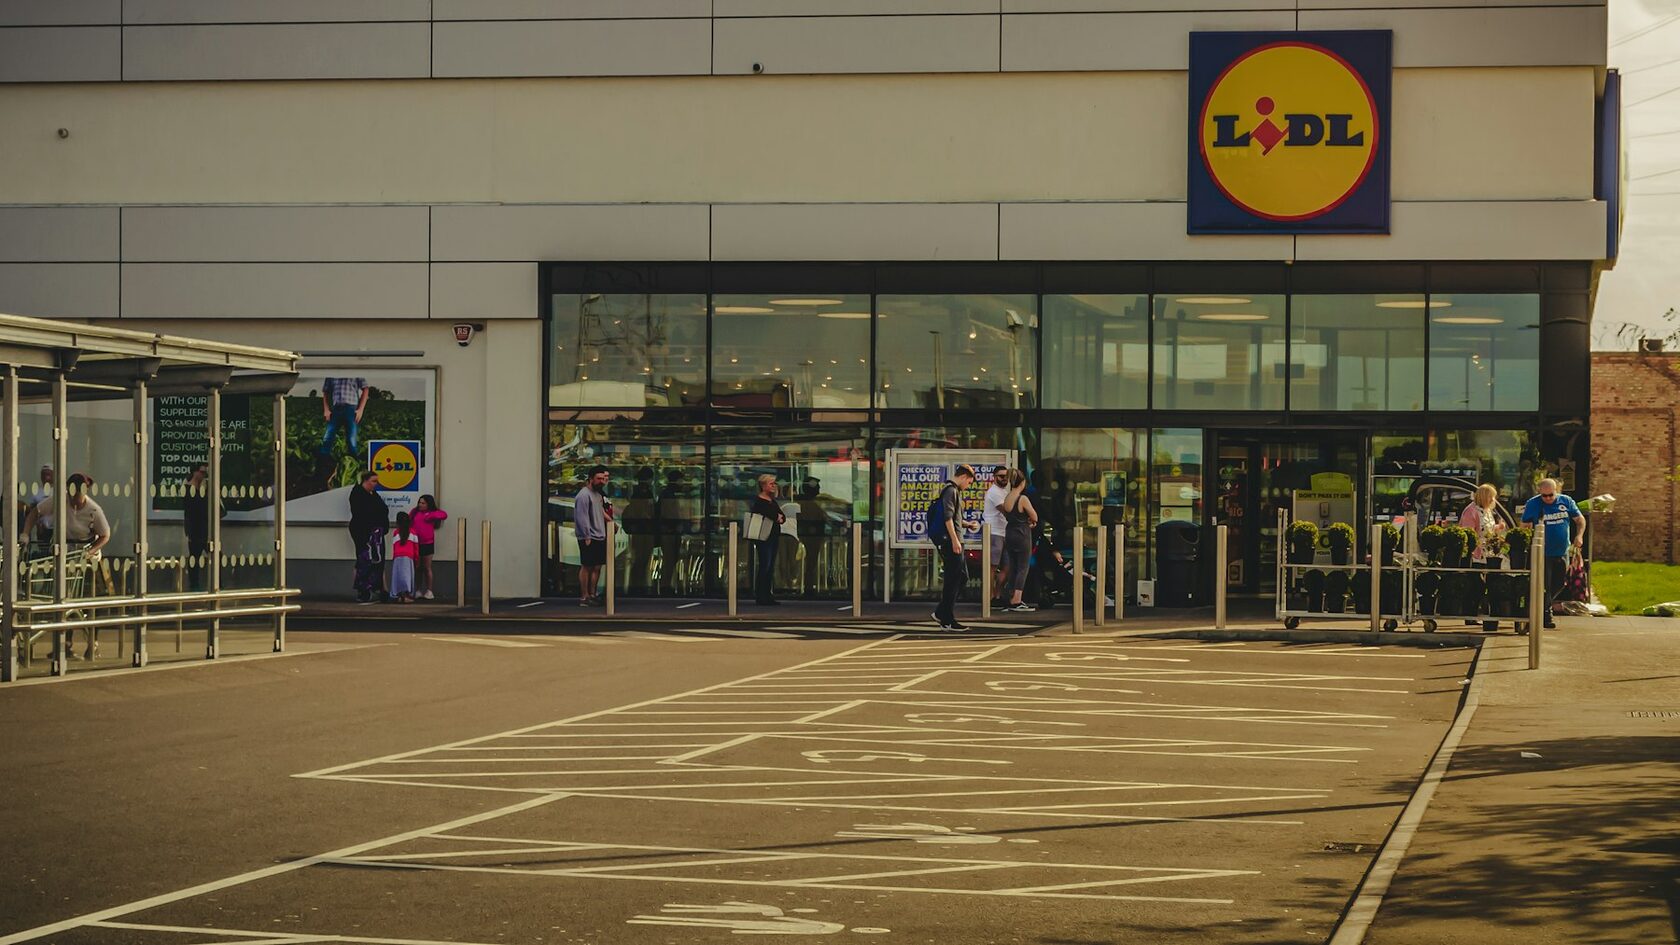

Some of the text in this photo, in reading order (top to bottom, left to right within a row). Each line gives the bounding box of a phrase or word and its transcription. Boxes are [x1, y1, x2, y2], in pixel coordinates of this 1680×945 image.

[160, 396, 207, 405] WITH OUR
[160, 408, 208, 417] SUPPLIERS
[228, 420, 247, 429] ARE
[160, 454, 180, 463] TOP
[901, 473, 940, 482] ALL OUR
[901, 491, 941, 500] SPECIA
[901, 501, 930, 511] OFFE
[900, 512, 928, 520] IN-ST
[1543, 512, 1569, 520] ANGERS
[900, 520, 929, 535] NO
